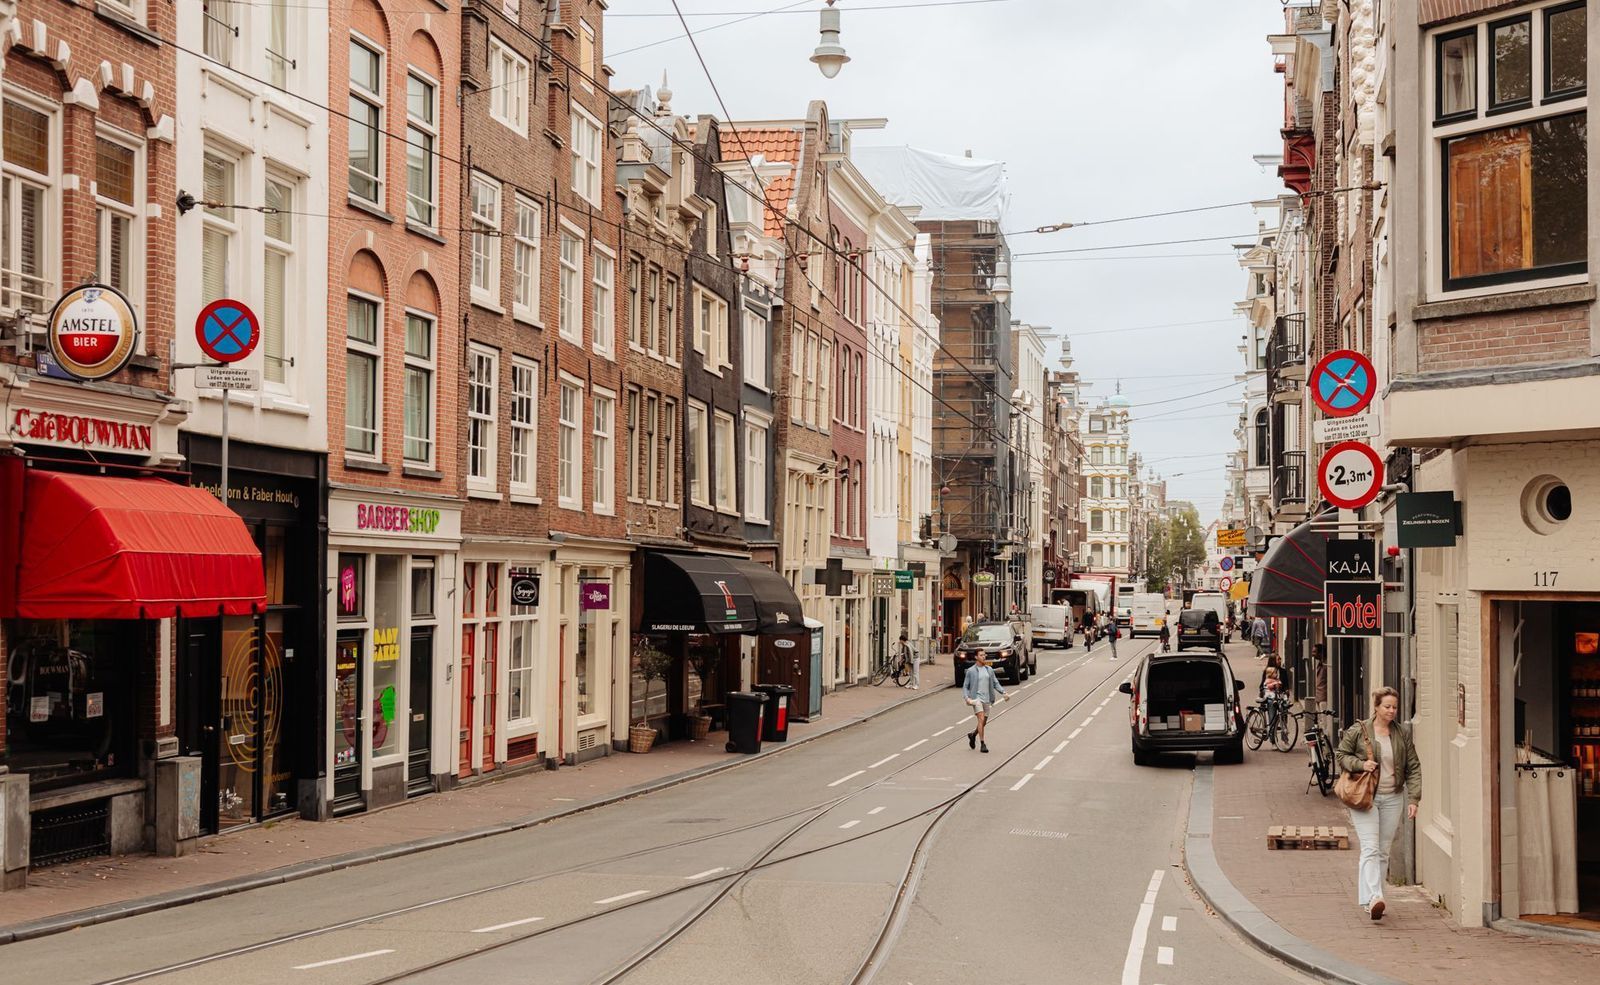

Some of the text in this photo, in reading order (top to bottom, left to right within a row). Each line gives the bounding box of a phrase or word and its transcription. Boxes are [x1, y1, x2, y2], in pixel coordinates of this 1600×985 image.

[61, 318, 115, 332] AMSTEL
[73, 337, 98, 347] BIER
[15, 408, 152, 450] Café BOUWMAN
[1327, 416, 1365, 426] Uitgezonderd
[243, 486, 249, 500] &
[251, 487, 274, 501] Faber
[275, 490, 293, 504] Hout
[357, 503, 440, 533] BARBERSHOP
[1329, 560, 1371, 574] KAJA
[1533, 571, 1559, 587] 117
[1328, 593, 1381, 629] hotel
